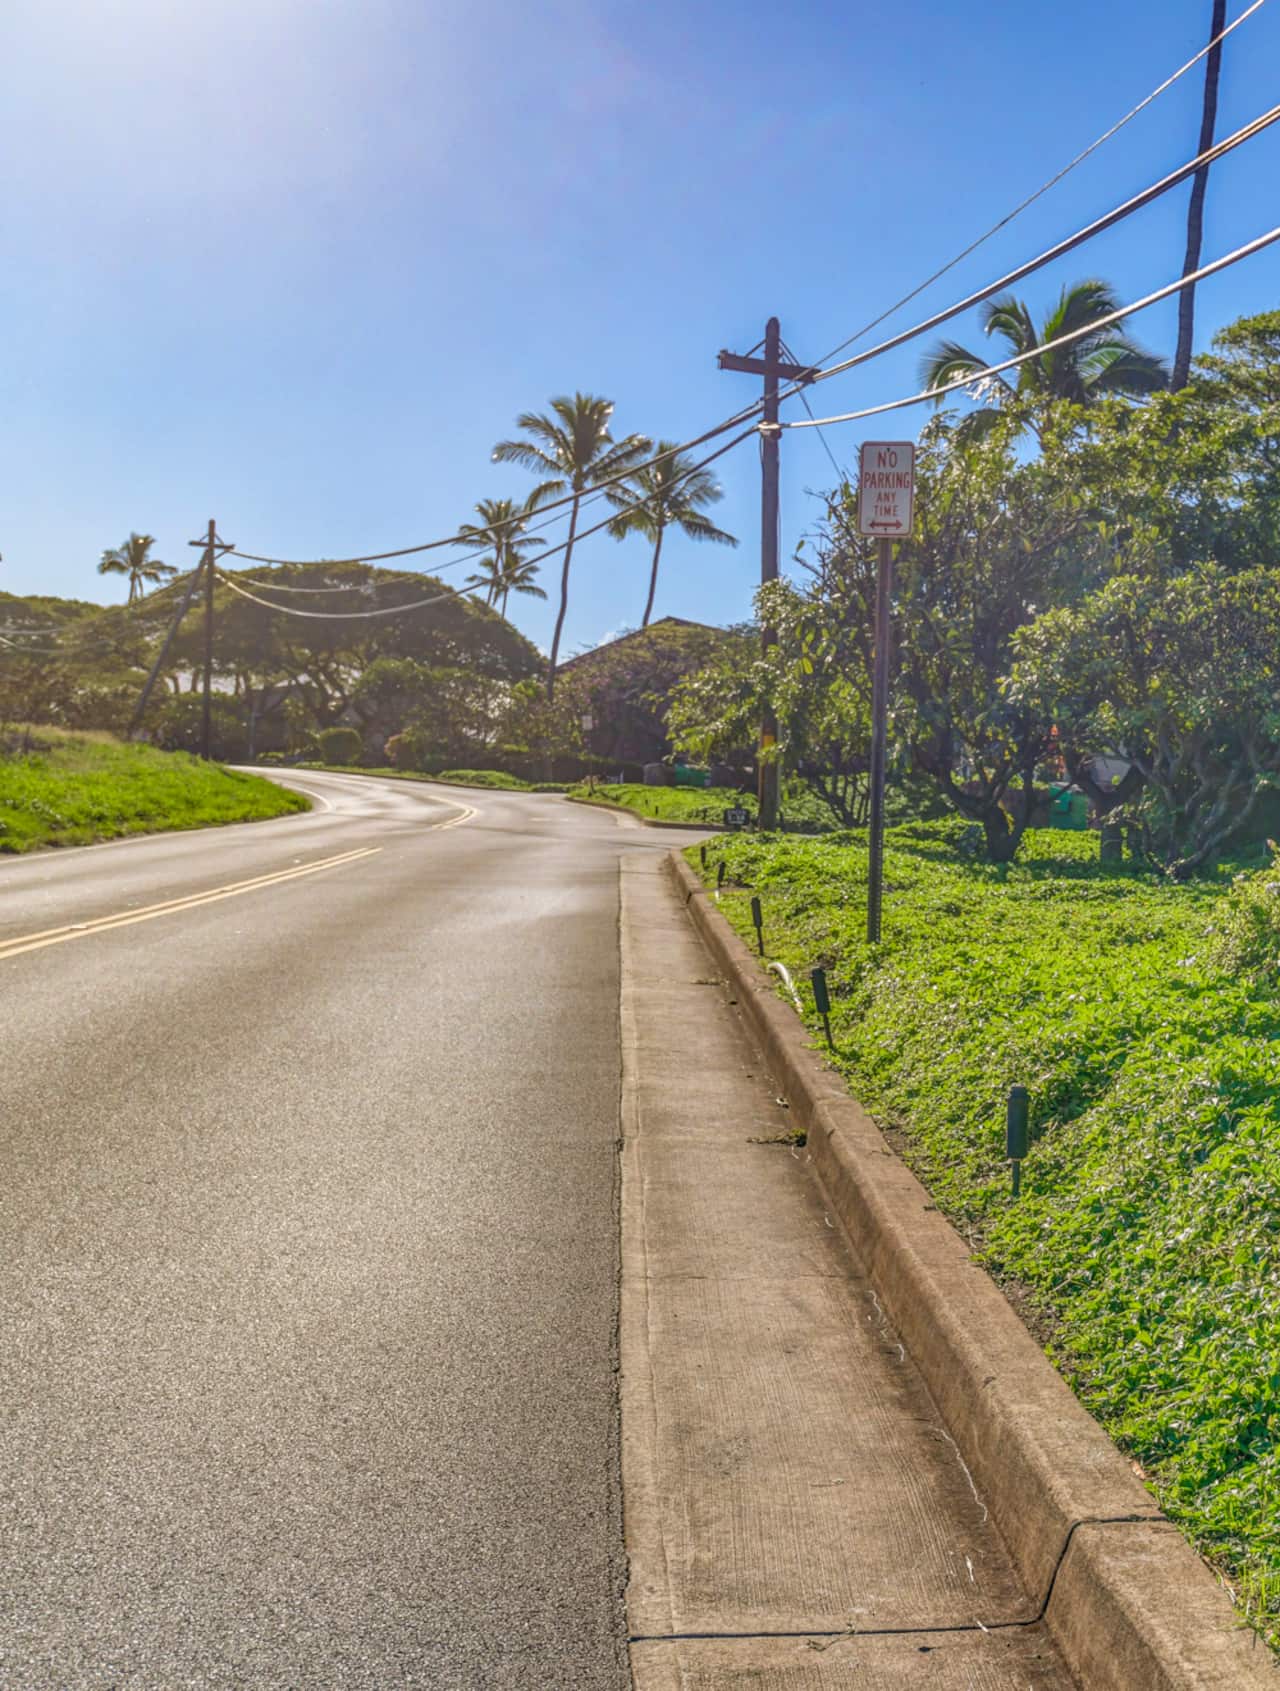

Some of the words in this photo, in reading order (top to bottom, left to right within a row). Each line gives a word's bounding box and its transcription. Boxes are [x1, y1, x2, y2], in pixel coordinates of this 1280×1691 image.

[878, 451, 897, 468] NO
[864, 472, 910, 488] PARKING
[876, 491, 896, 503] ANY
[873, 505, 898, 517] TIME
